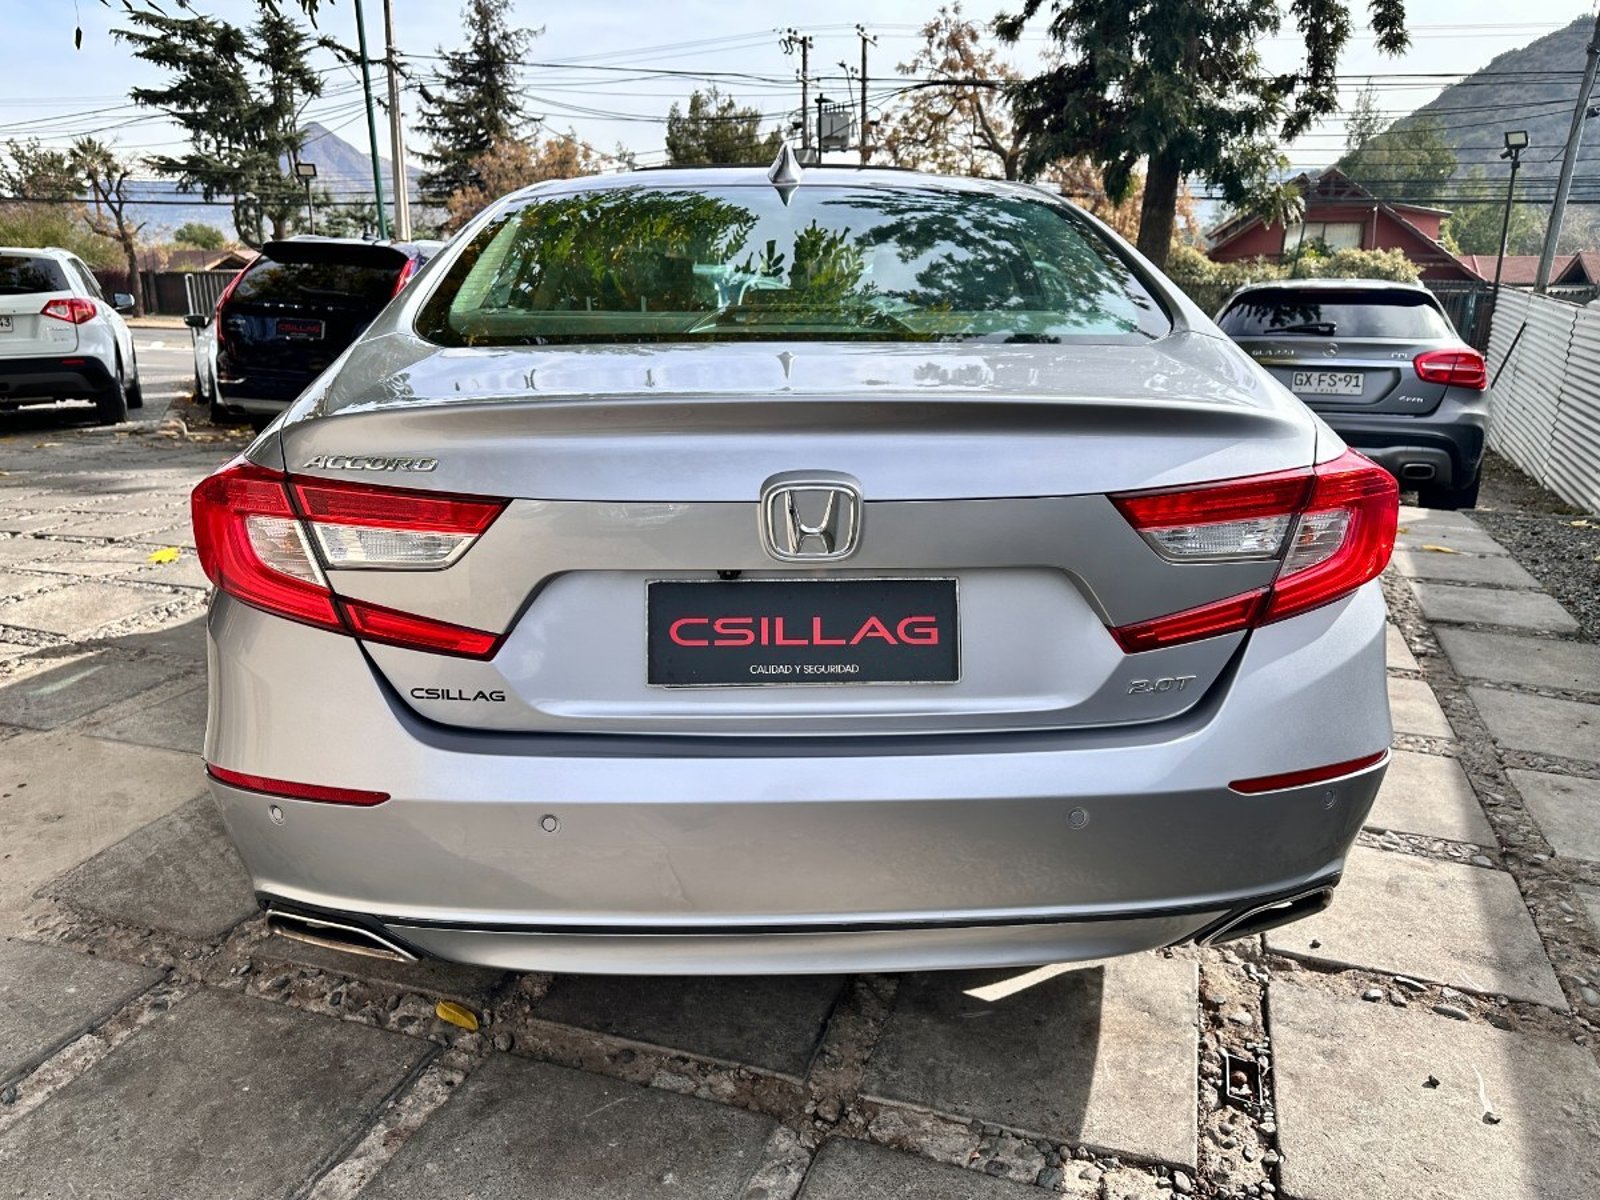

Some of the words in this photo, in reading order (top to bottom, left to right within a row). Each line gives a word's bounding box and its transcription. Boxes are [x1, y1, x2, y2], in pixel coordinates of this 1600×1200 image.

[303, 455, 440, 472] ACCORD
[669, 616, 939, 646] CSILLAG
[749, 664, 793, 675] CALIDAD
[794, 664, 802, 675] Y
[803, 664, 860, 675] SEGURIDAD
[1127, 675, 1197, 695] 2.0T
[410, 687, 506, 702] CSILLAG
